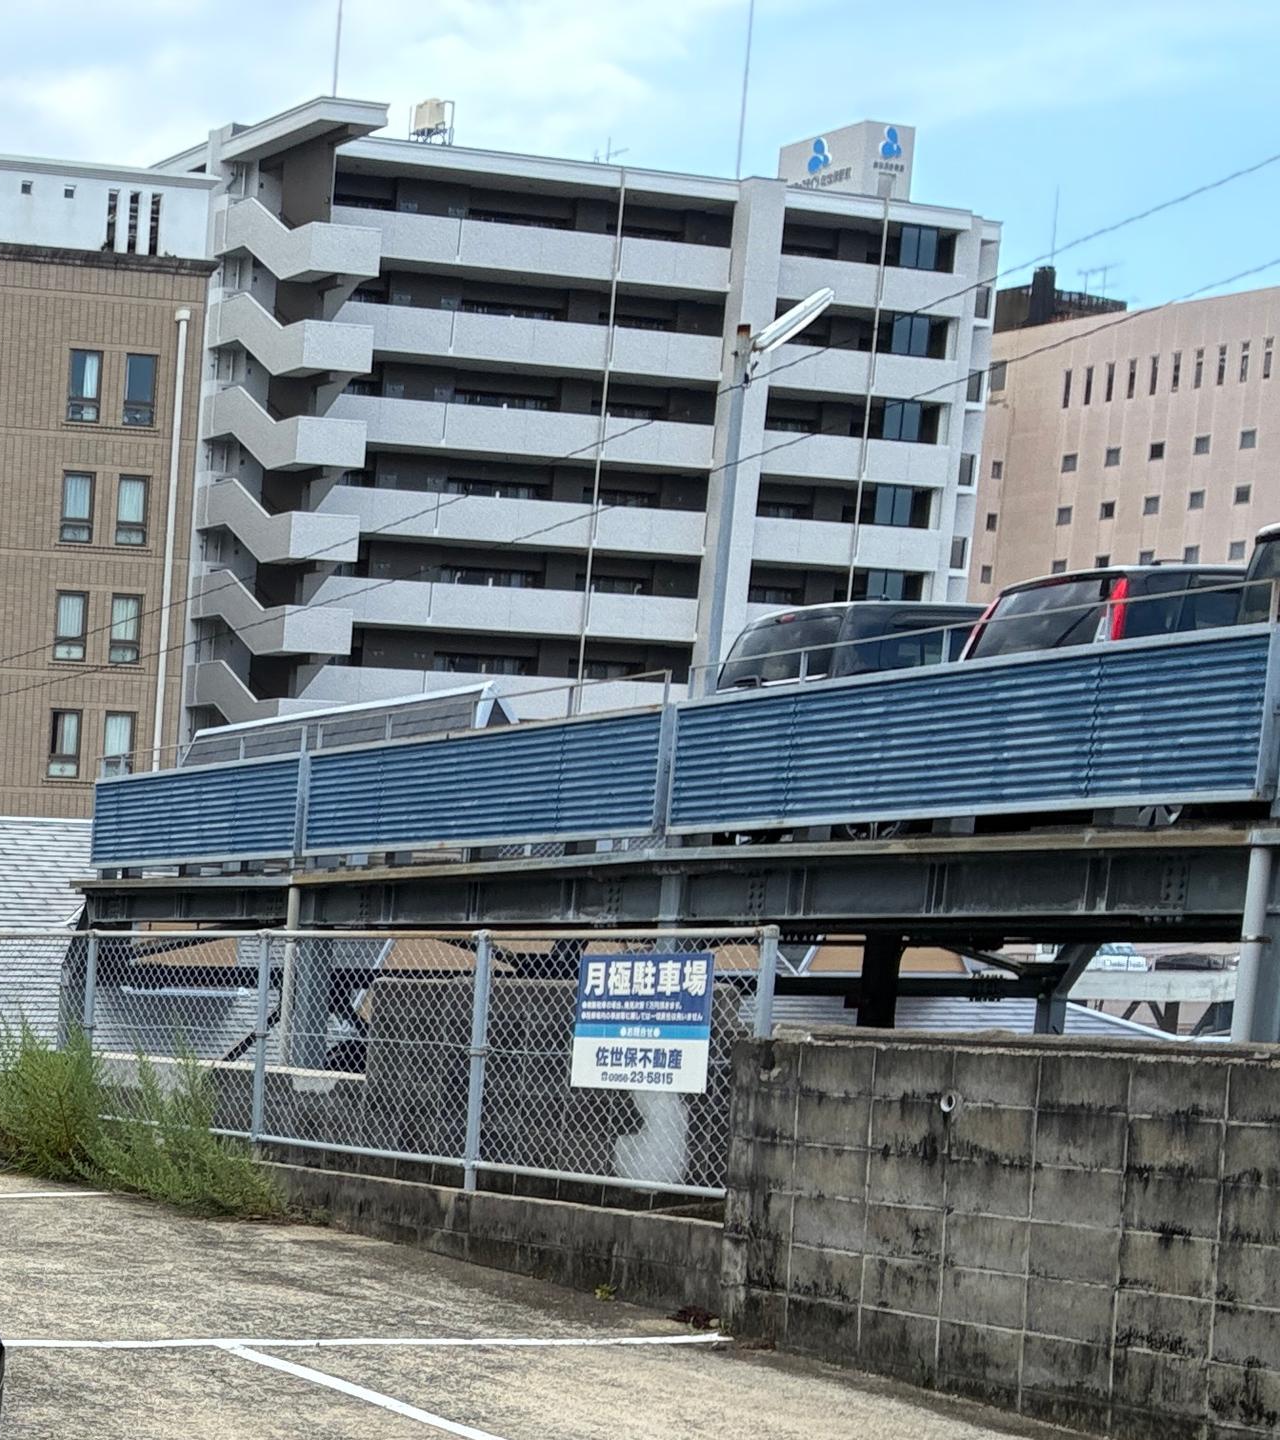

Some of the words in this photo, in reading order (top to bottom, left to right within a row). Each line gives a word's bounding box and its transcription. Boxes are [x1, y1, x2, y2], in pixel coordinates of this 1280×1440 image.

[584, 960, 708, 997] 月極駐車場
[595, 1046, 683, 1070] 佐世保不動産
